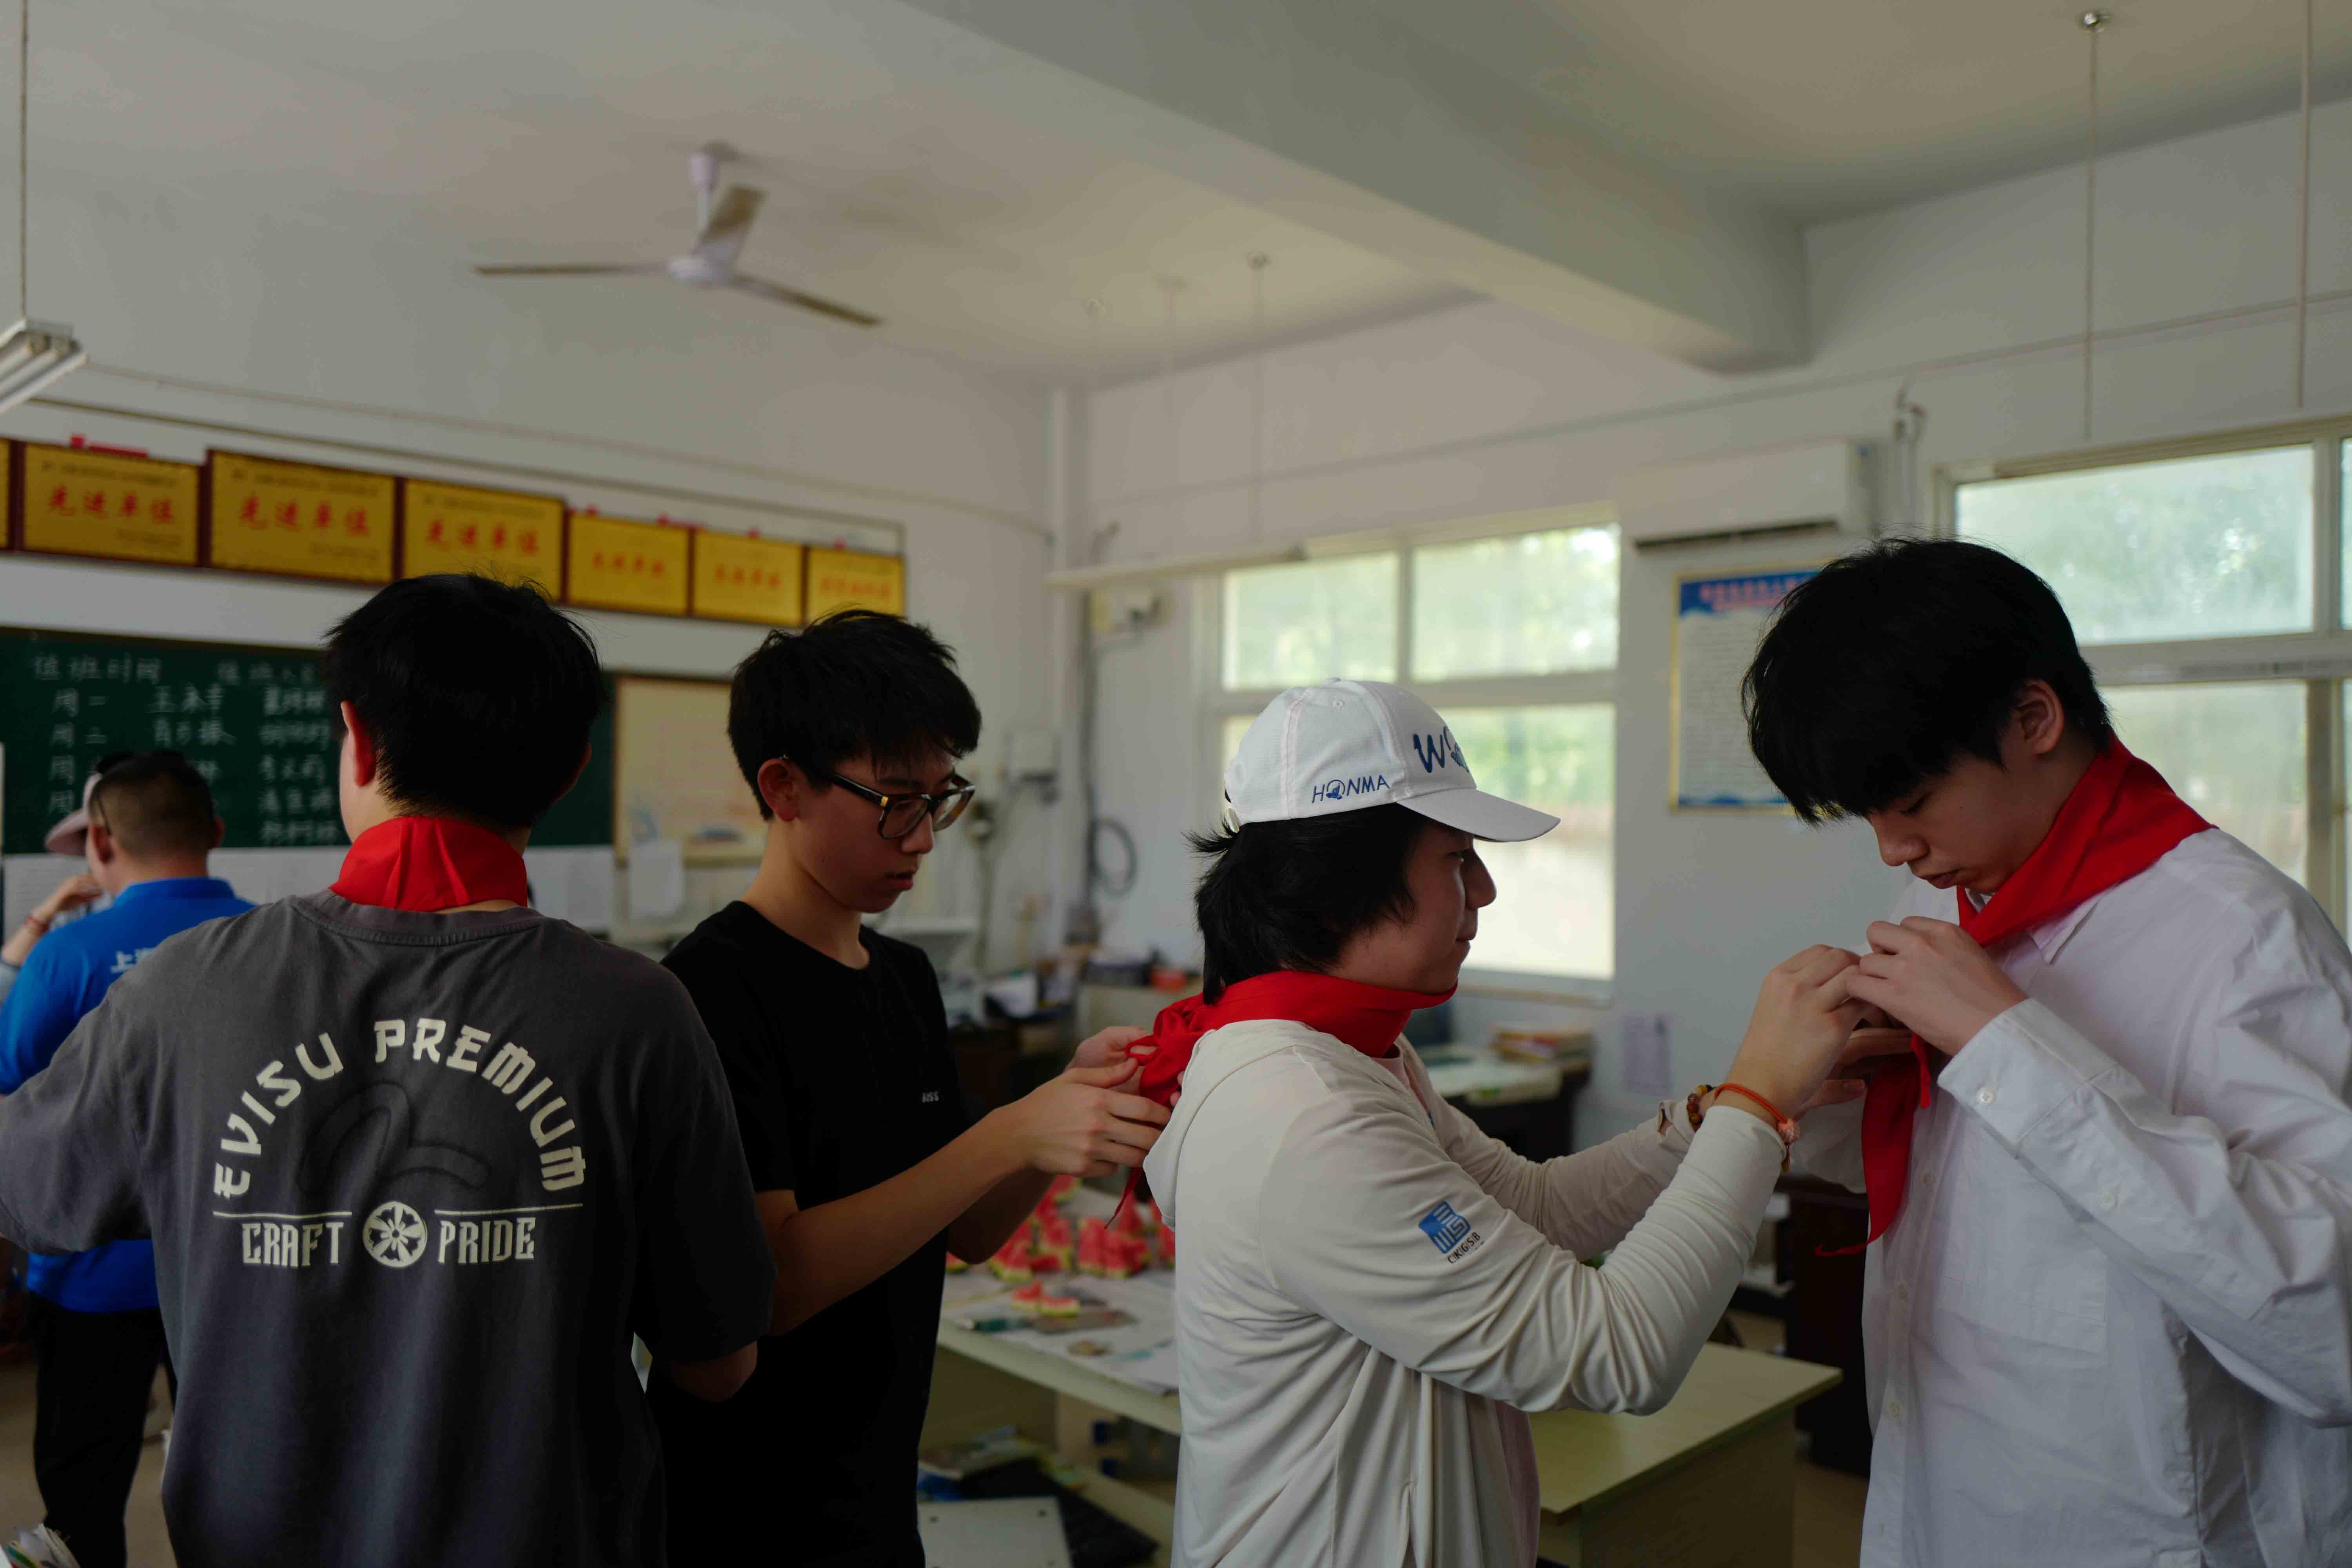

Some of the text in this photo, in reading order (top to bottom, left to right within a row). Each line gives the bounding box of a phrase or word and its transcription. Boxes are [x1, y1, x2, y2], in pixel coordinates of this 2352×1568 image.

[1312, 775, 1390, 803] HONMA
[214, 1018, 586, 1199] EVISU PREMIUM
[241, 1216, 536, 1267] CRAFT PRIDE
